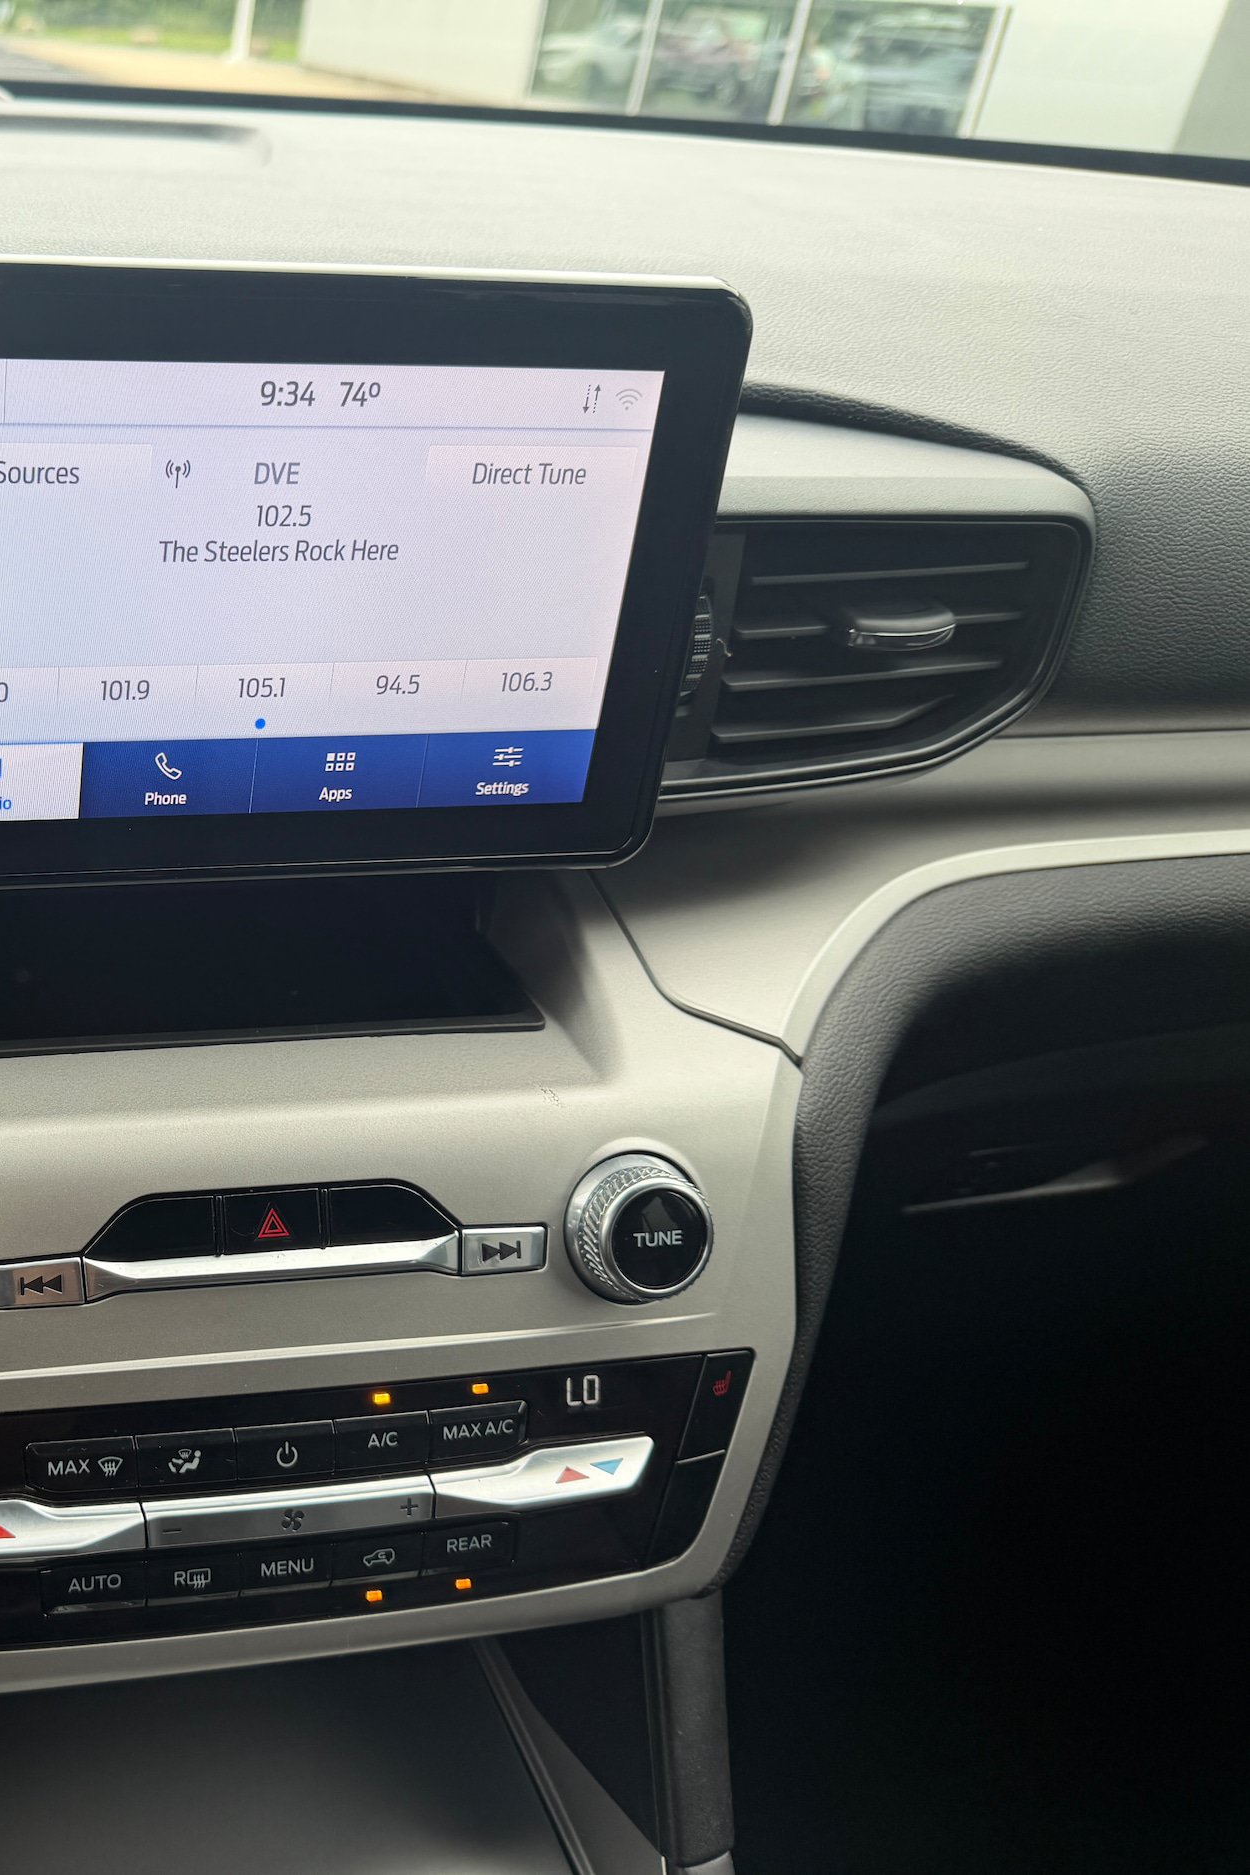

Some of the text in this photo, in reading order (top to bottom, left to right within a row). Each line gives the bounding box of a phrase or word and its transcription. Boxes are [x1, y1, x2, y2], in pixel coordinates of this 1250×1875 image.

[260, 380, 316, 407] 9:34
[253, 462, 301, 485] DVE
[472, 462, 587, 485] Direct Tune
[256, 504, 312, 527] 102.5
[158, 538, 399, 563] The Steelers Rock Here
[100, 679, 150, 701] 101.9
[238, 677, 286, 698] 105.1
[376, 674, 421, 695] 94.5
[501, 671, 553, 693] 106.3
[144, 791, 187, 806] Phone
[318, 786, 353, 803] Apps
[475, 781, 530, 797] Settings
[632, 1229, 683, 1248] TUNE
[367, 1431, 398, 1448] A/C
[443, 1419, 514, 1440] MAX A/C
[47, 1458, 91, 1476] MAX
[446, 1534, 492, 1553] REAR
[260, 1557, 314, 1577] MENU
[68, 1573, 122, 1593] AUTO
